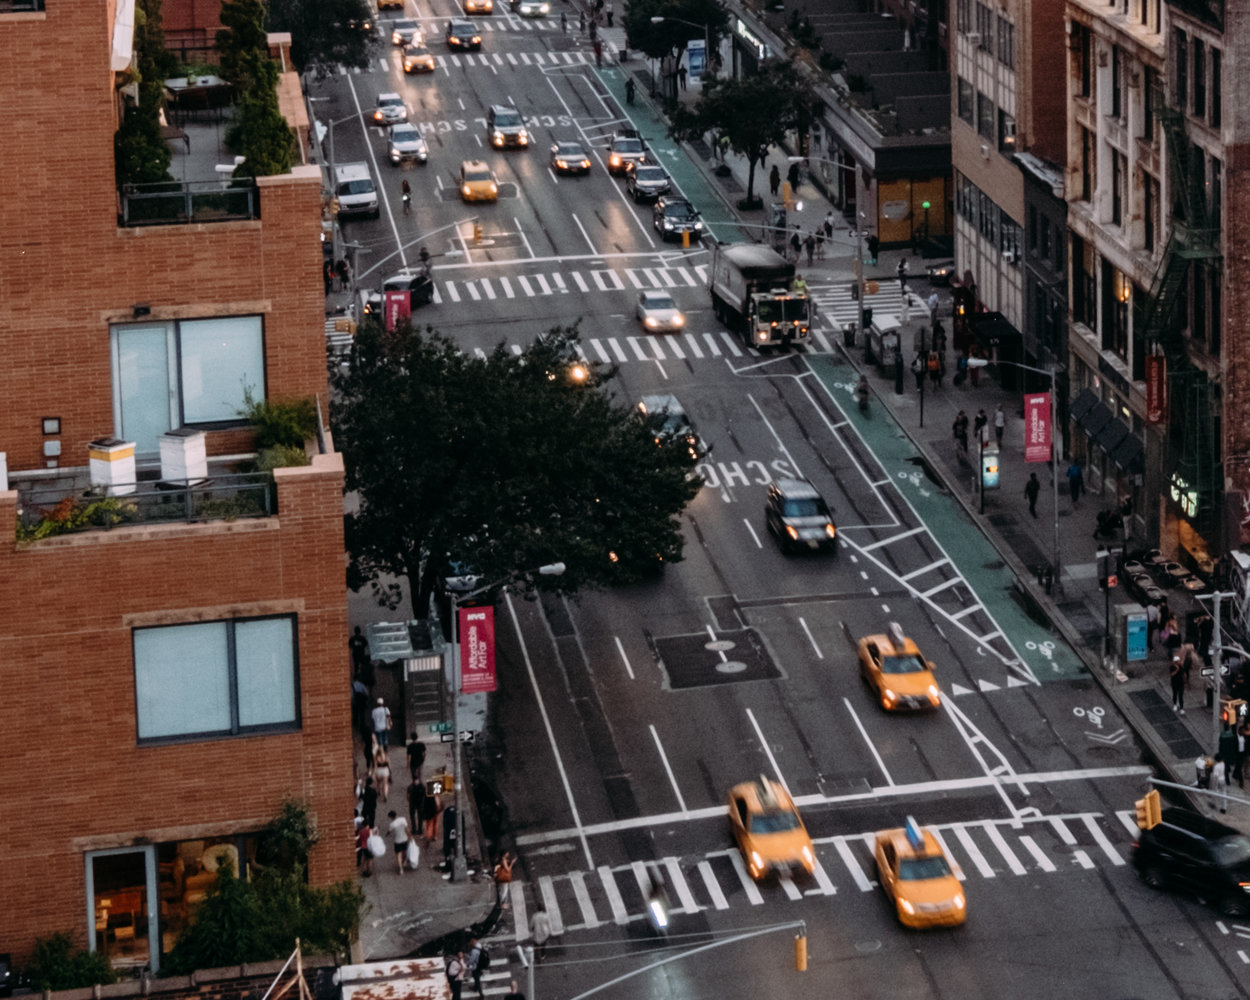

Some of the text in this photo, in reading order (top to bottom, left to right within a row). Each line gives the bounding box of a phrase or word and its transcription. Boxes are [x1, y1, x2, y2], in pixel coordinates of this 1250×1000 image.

[695, 459, 796, 488] SCHO
[468, 626, 477, 669] Affordable
[477, 640, 487, 669] Art Fair
